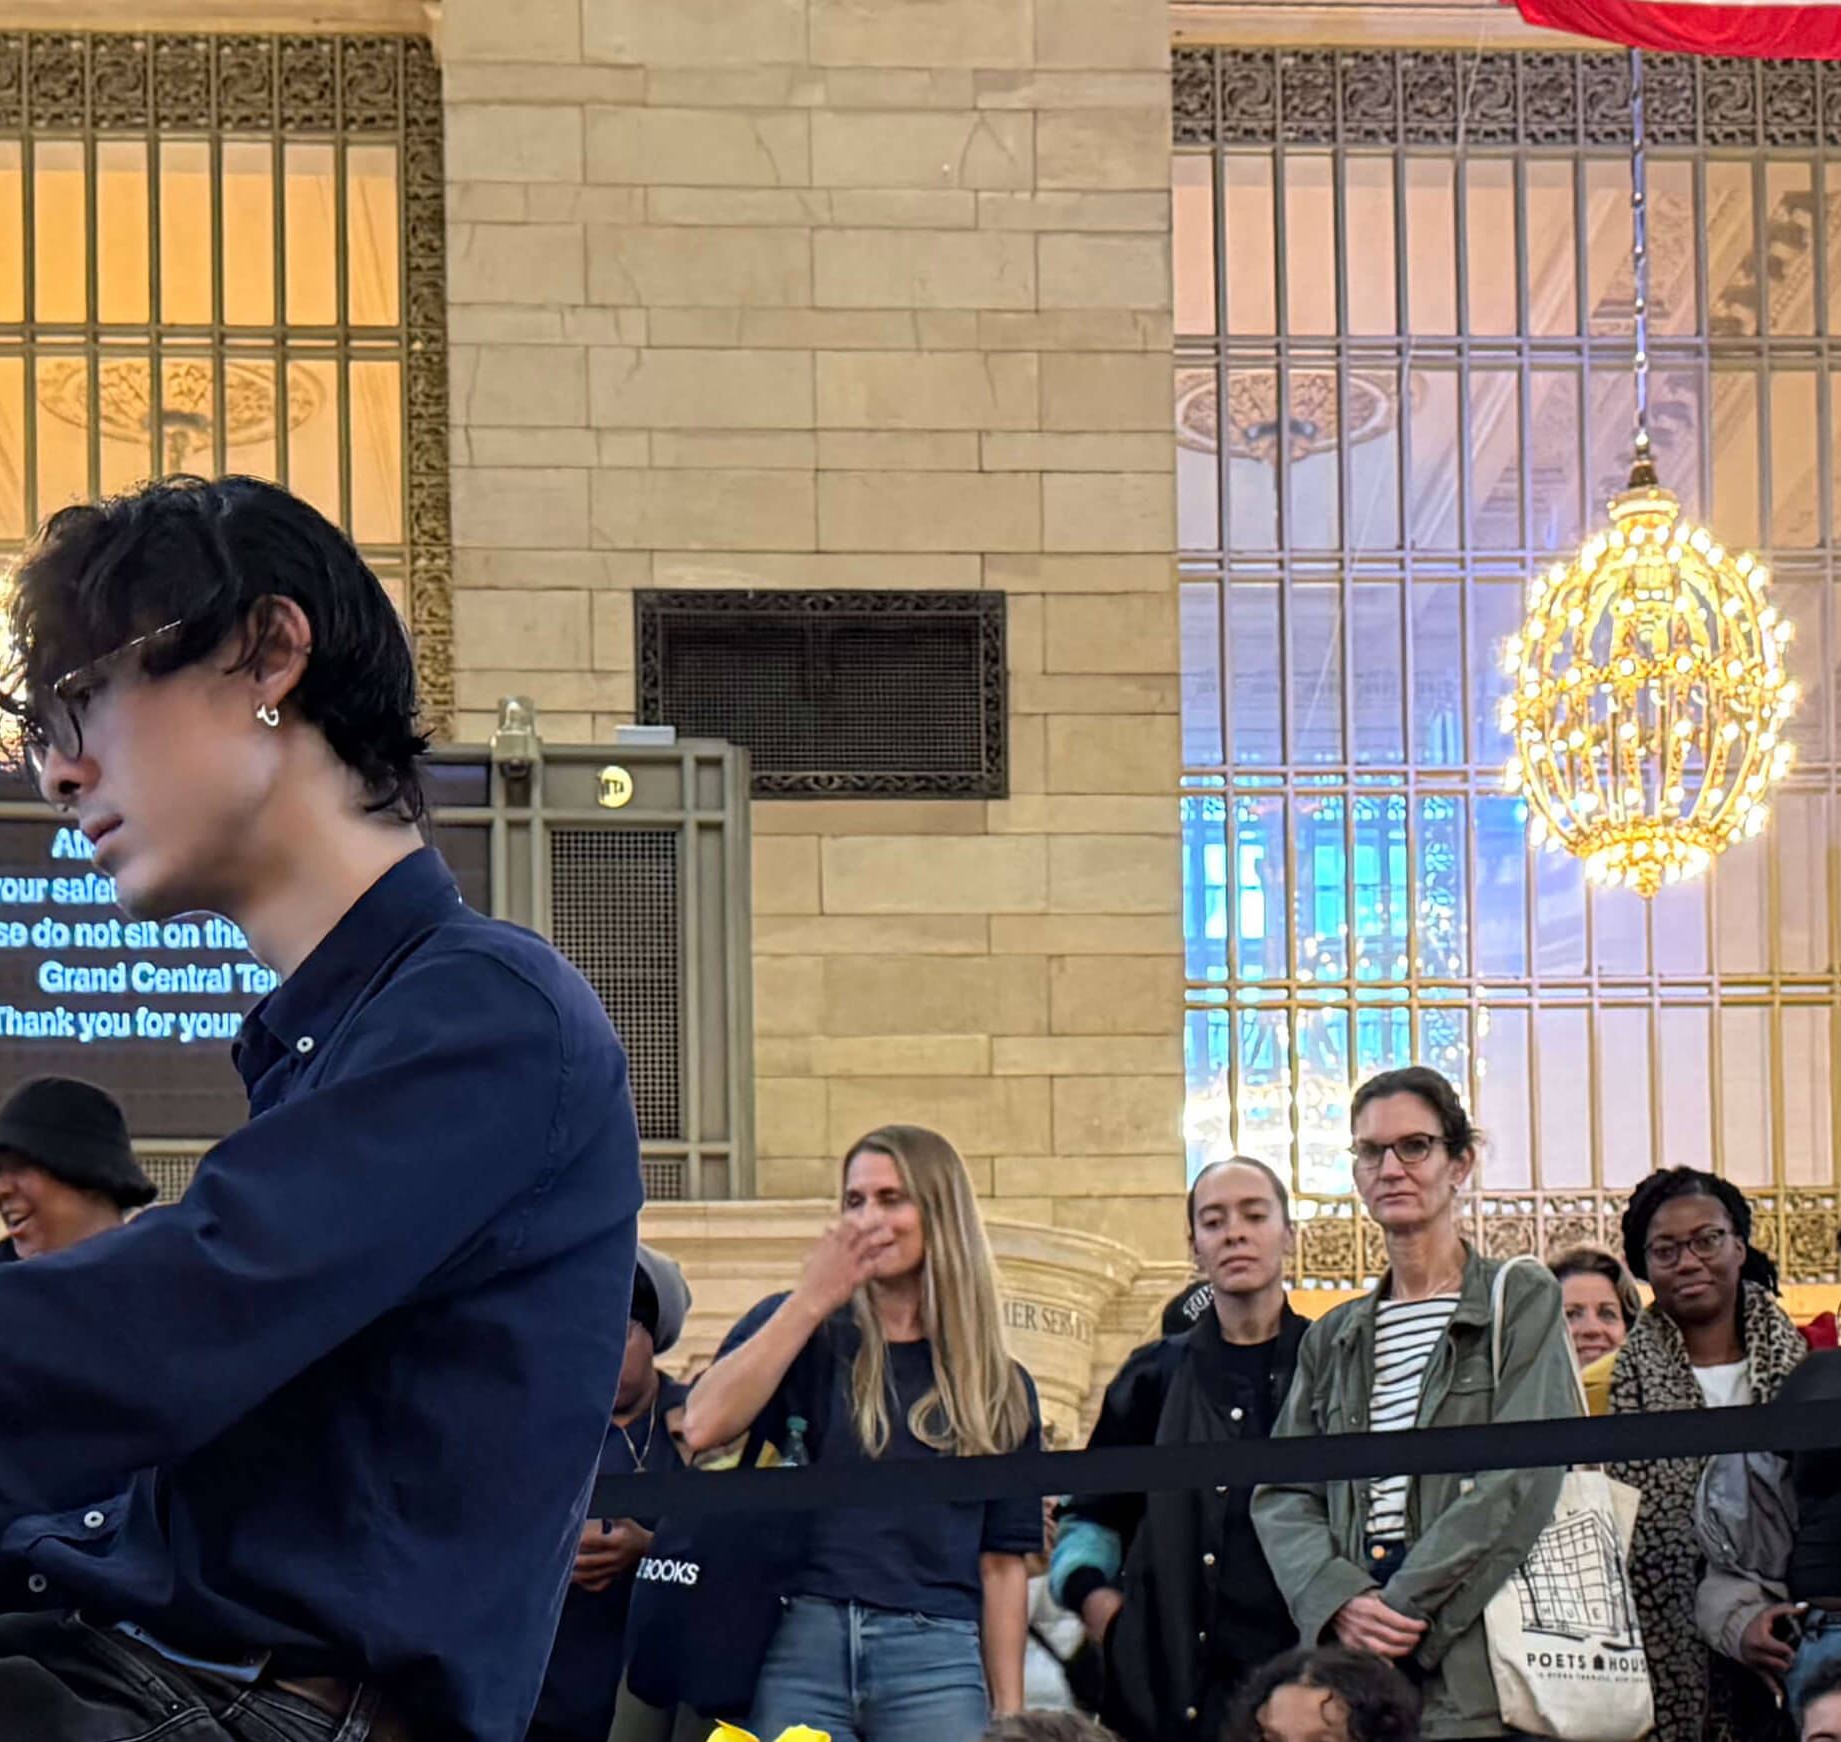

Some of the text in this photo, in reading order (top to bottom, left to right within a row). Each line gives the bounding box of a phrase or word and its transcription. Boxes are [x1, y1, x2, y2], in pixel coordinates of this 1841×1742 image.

[31, 916, 70, 949] do
[73, 918, 121, 949] not
[124, 916, 159, 949] sit
[162, 922, 201, 949] on
[38, 962, 127, 994] Grand
[130, 961, 232, 994] Central
[78, 1012, 132, 1042] you
[135, 1005, 177, 1038] for
[1526, 1652, 1587, 1670] POETS
